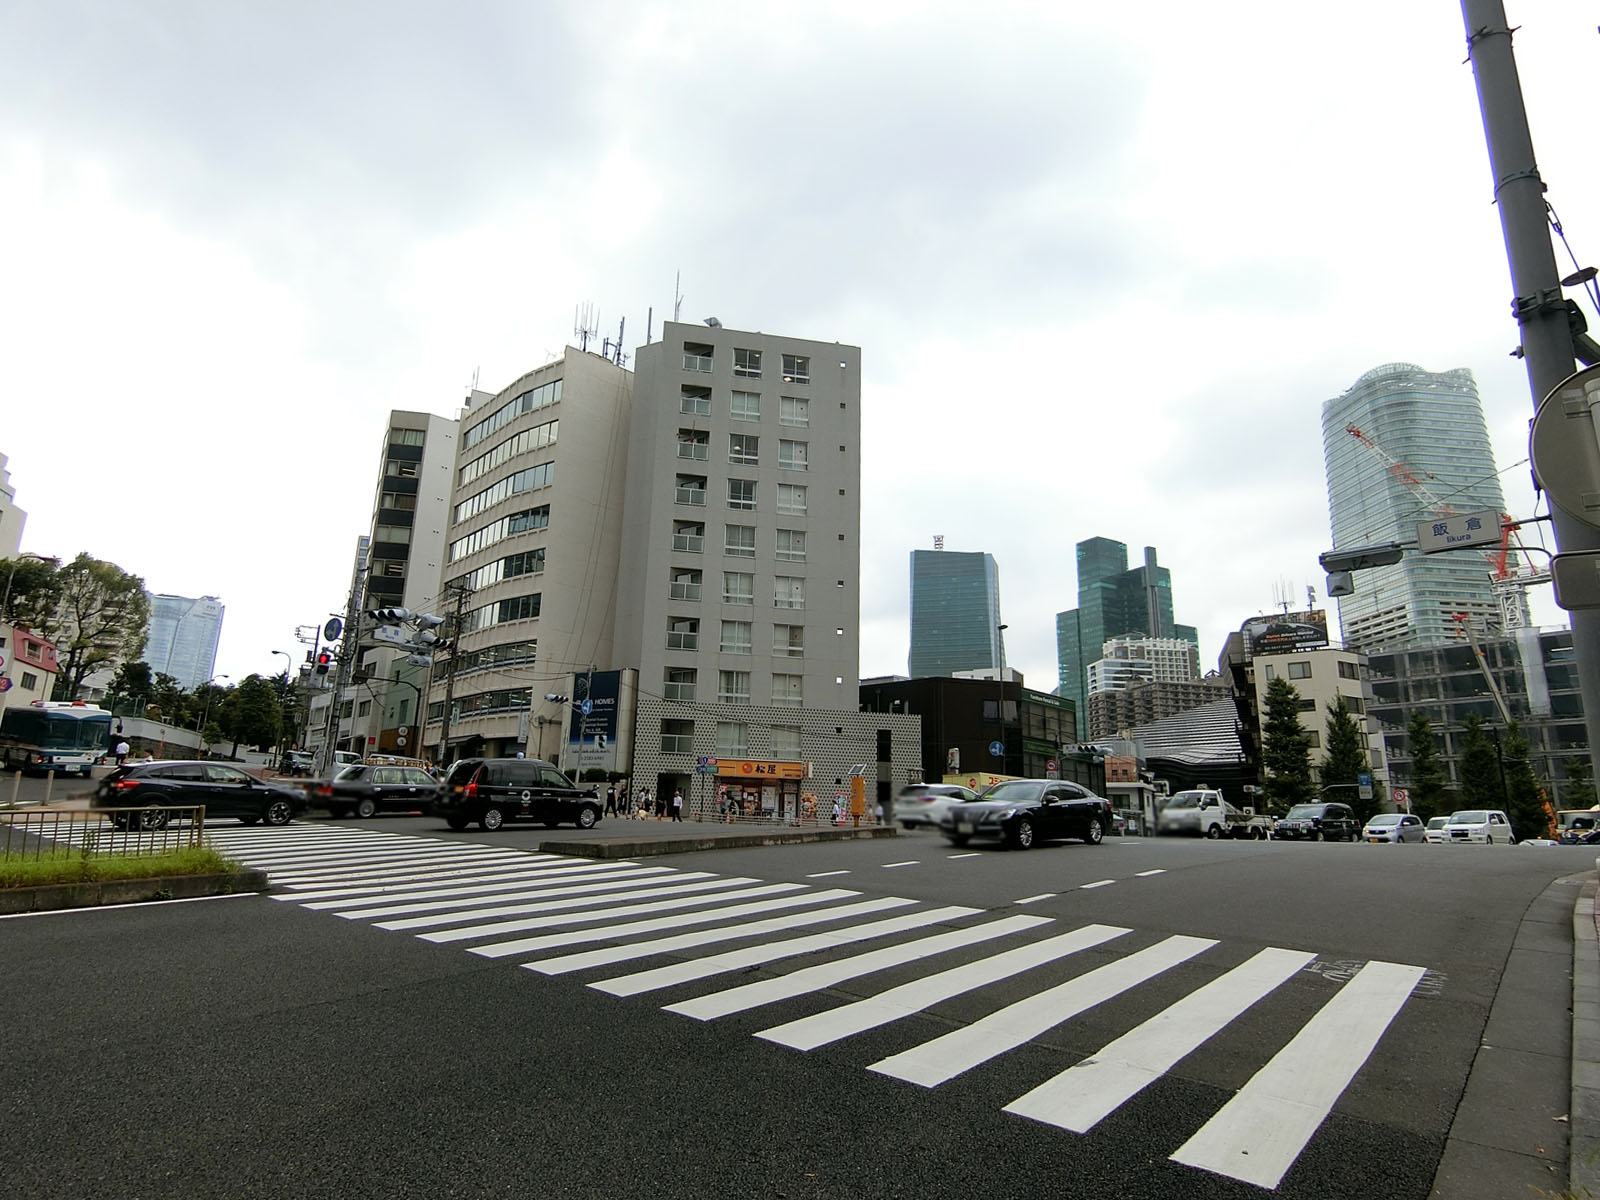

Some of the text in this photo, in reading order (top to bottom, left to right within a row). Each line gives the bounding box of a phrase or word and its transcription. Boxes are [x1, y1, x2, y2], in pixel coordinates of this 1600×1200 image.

[1432, 517, 1481, 536] 飯倉
[1446, 533, 1472, 543] Iikura
[755, 764, 777, 775] 松屋
